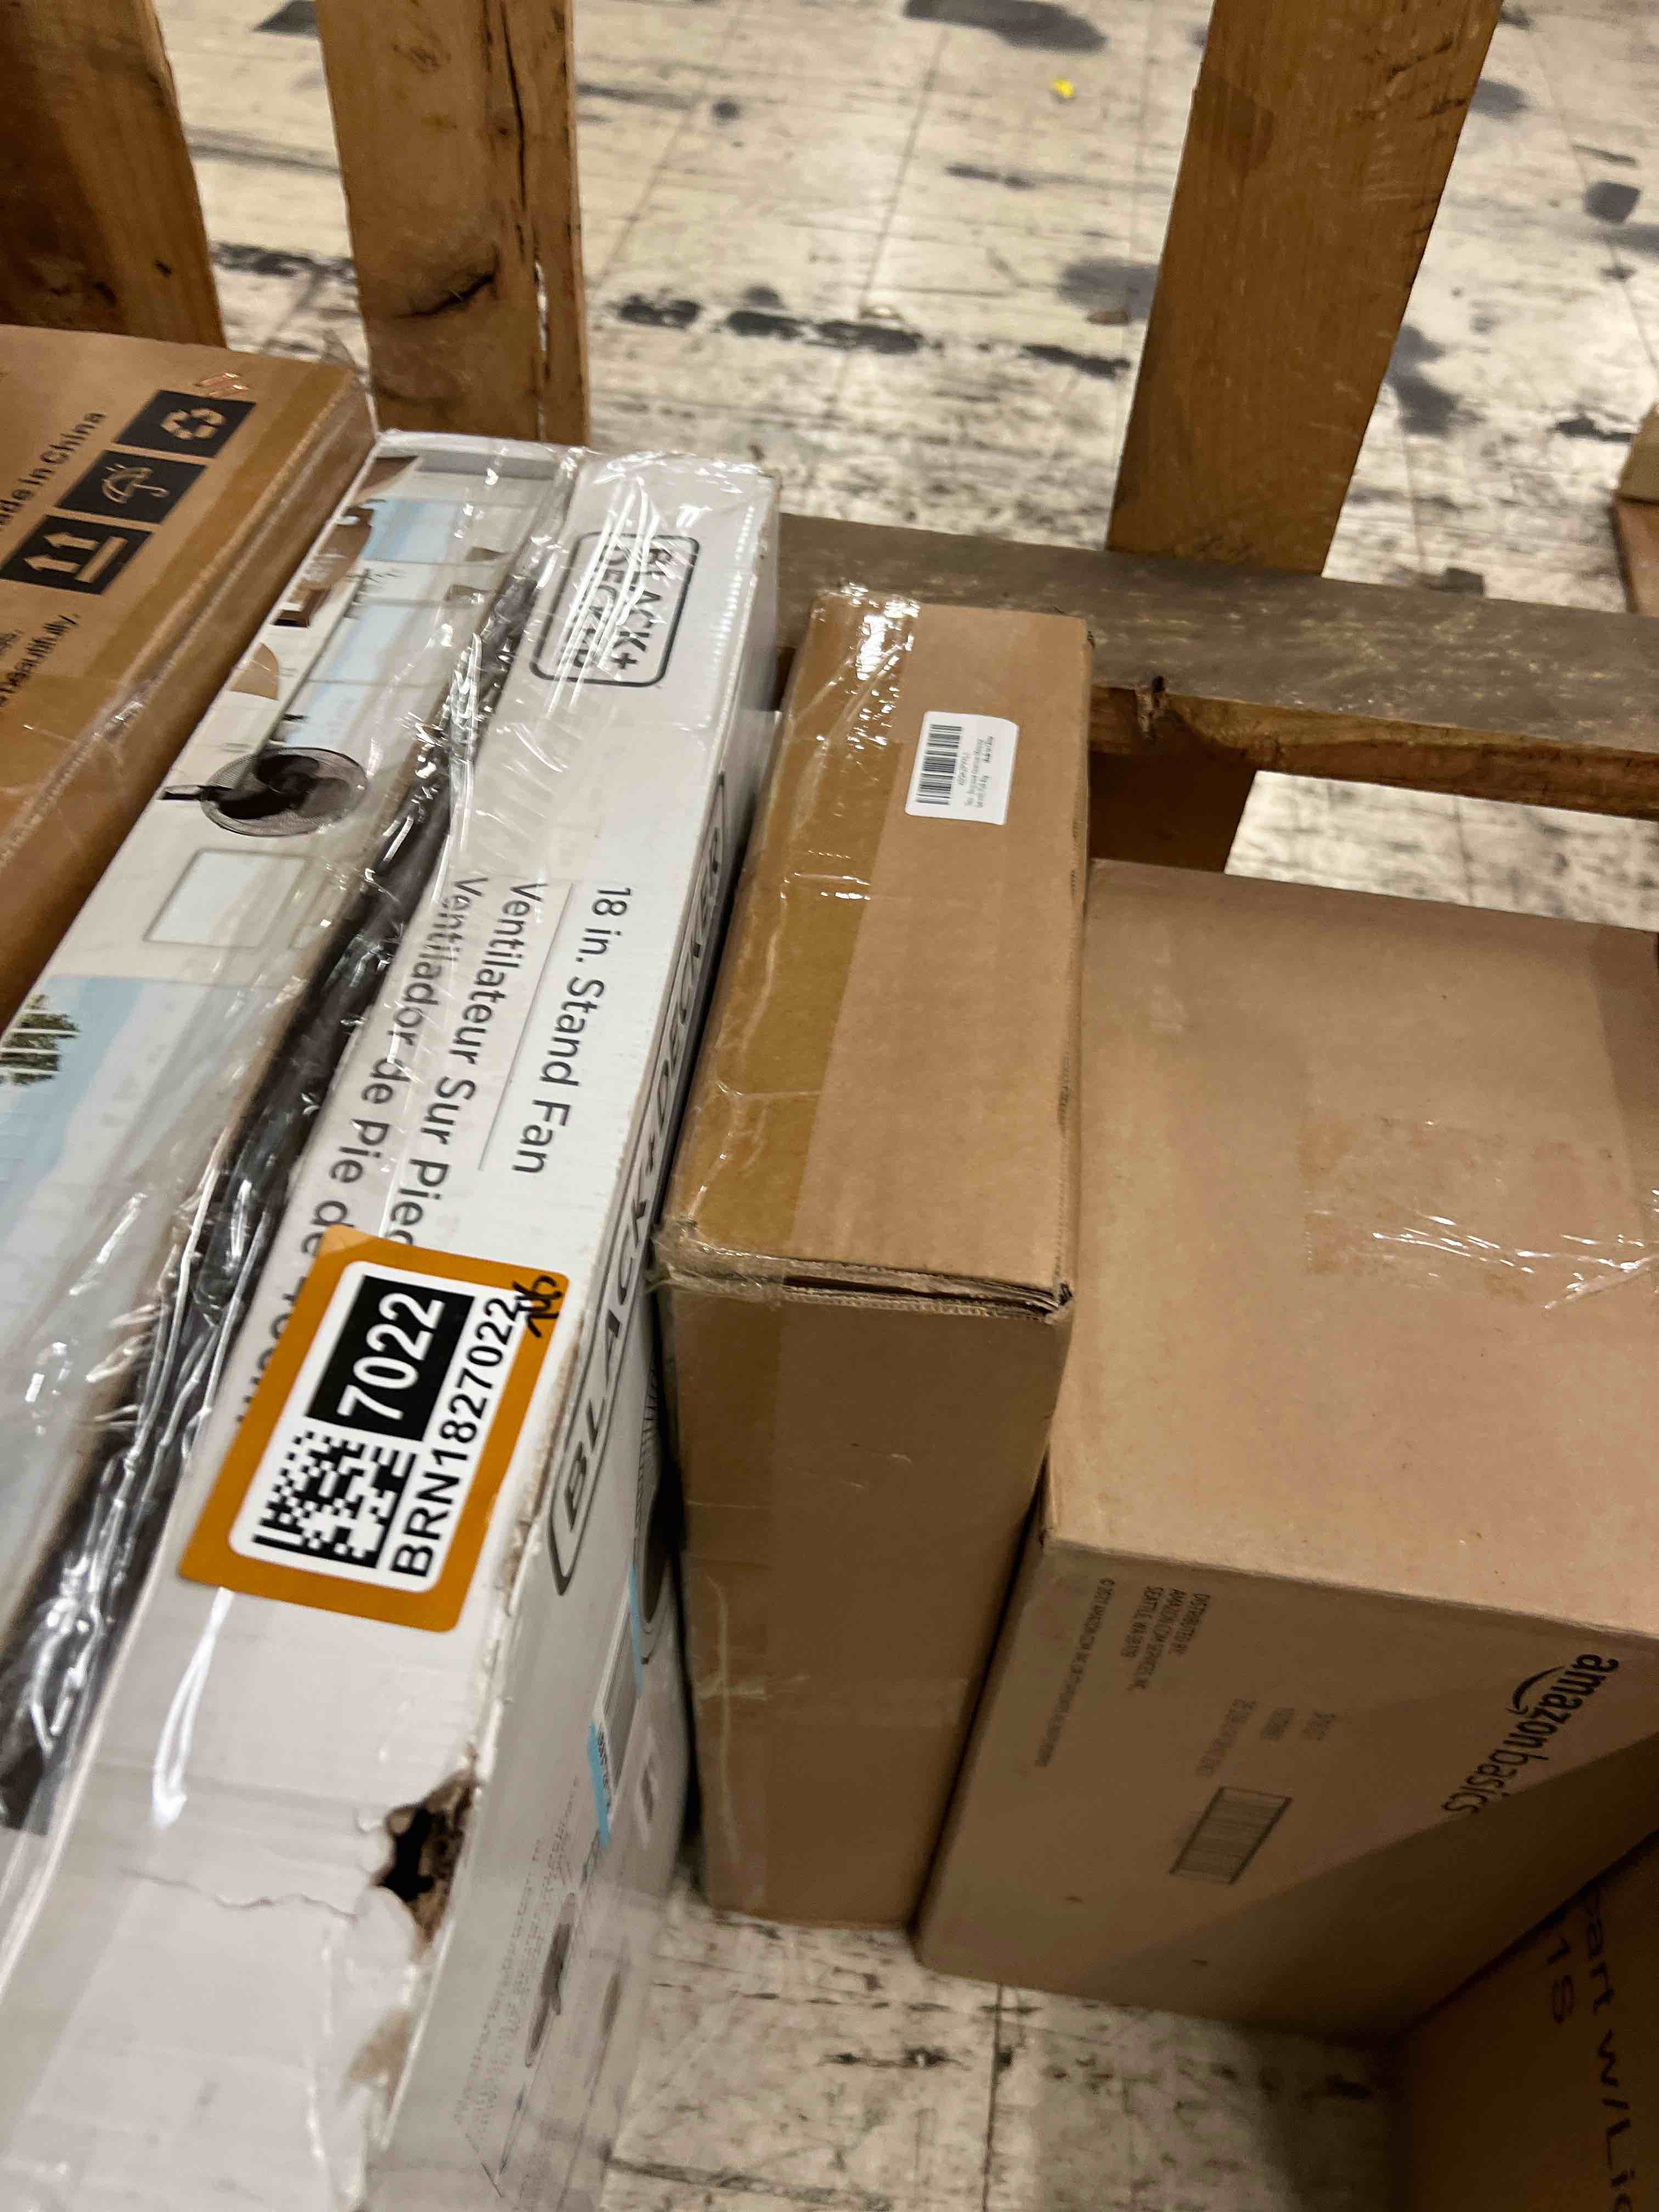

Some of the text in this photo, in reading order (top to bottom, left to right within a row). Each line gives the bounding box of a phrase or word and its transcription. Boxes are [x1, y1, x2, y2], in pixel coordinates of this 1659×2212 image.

[40, 412, 107, 465] China
[385, 877, 489, 1046] Ventilador
[450, 881, 549, 1065] Ventilateur
[359, 1057, 411, 1105] de
[511, 886, 633, 1175] 18 in. Stand Fan
[329, 1117, 391, 1185] Pie
[419, 1075, 477, 1146] Sur
[335, 1292, 447, 1421] 7022
[388, 1296, 518, 1578] BRN1827022
